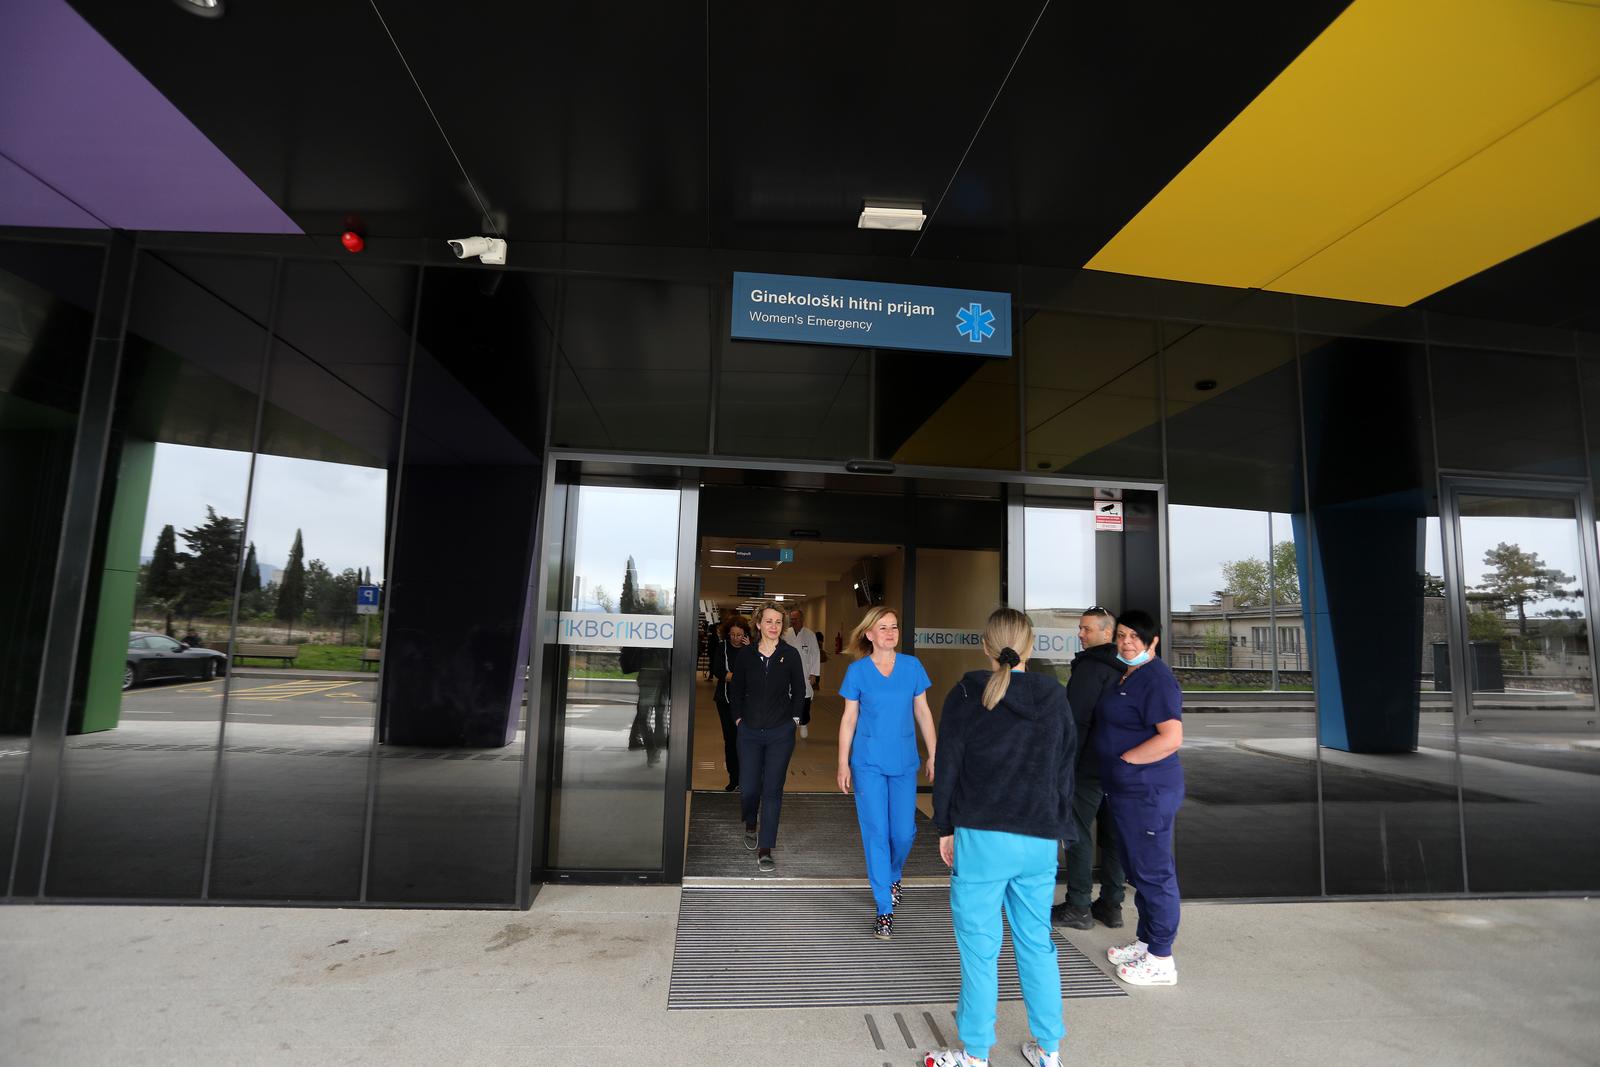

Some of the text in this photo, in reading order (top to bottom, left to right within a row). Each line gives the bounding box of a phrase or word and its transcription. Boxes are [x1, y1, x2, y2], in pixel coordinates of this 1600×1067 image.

[750, 289, 935, 317] Ginekološki hitni prijam
[749, 311, 873, 332] Women's Emergency
